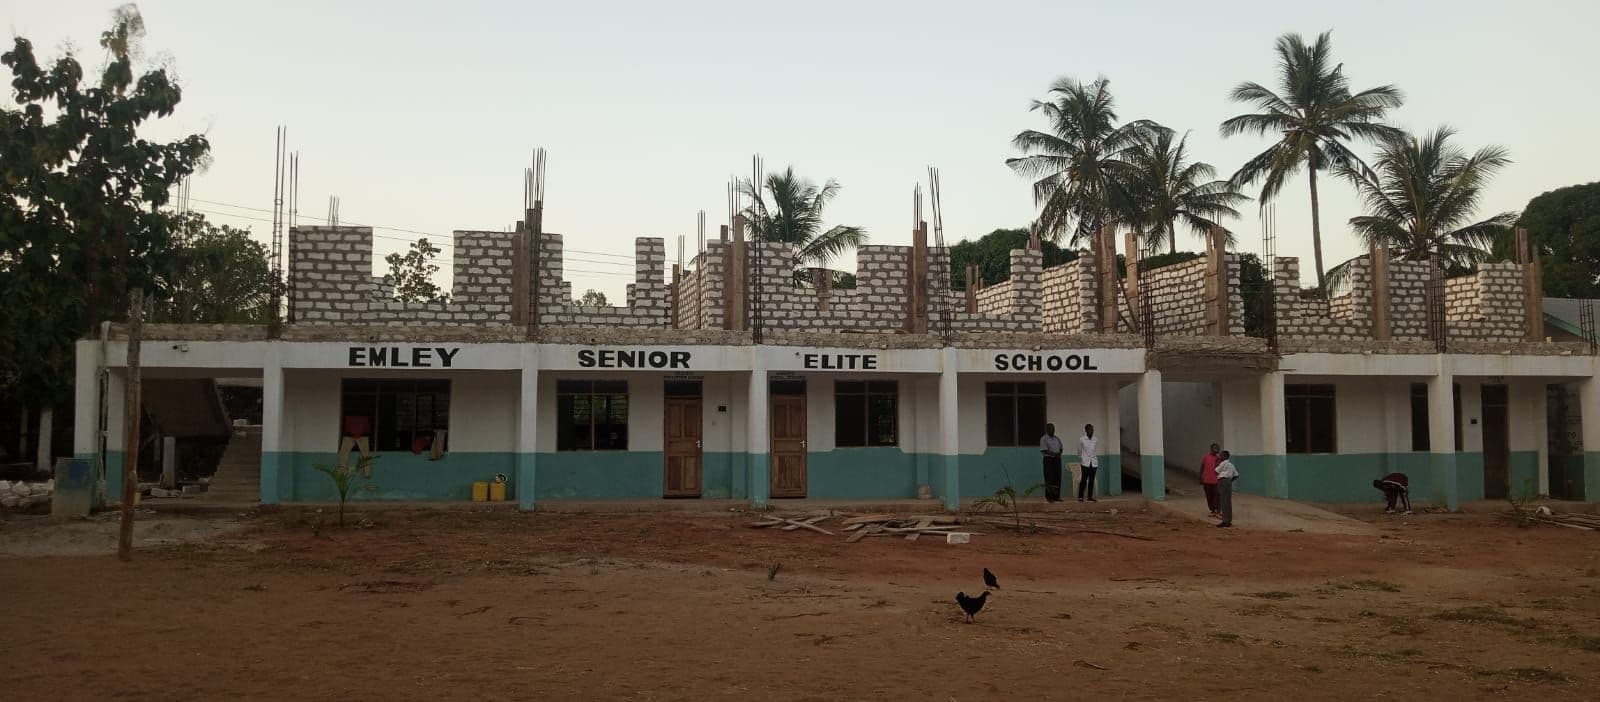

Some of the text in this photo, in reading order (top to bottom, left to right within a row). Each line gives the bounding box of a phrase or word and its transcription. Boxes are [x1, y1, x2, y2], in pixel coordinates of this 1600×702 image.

[349, 347, 1098, 371] EMLEY SENIOR ELITE SCHOOL
